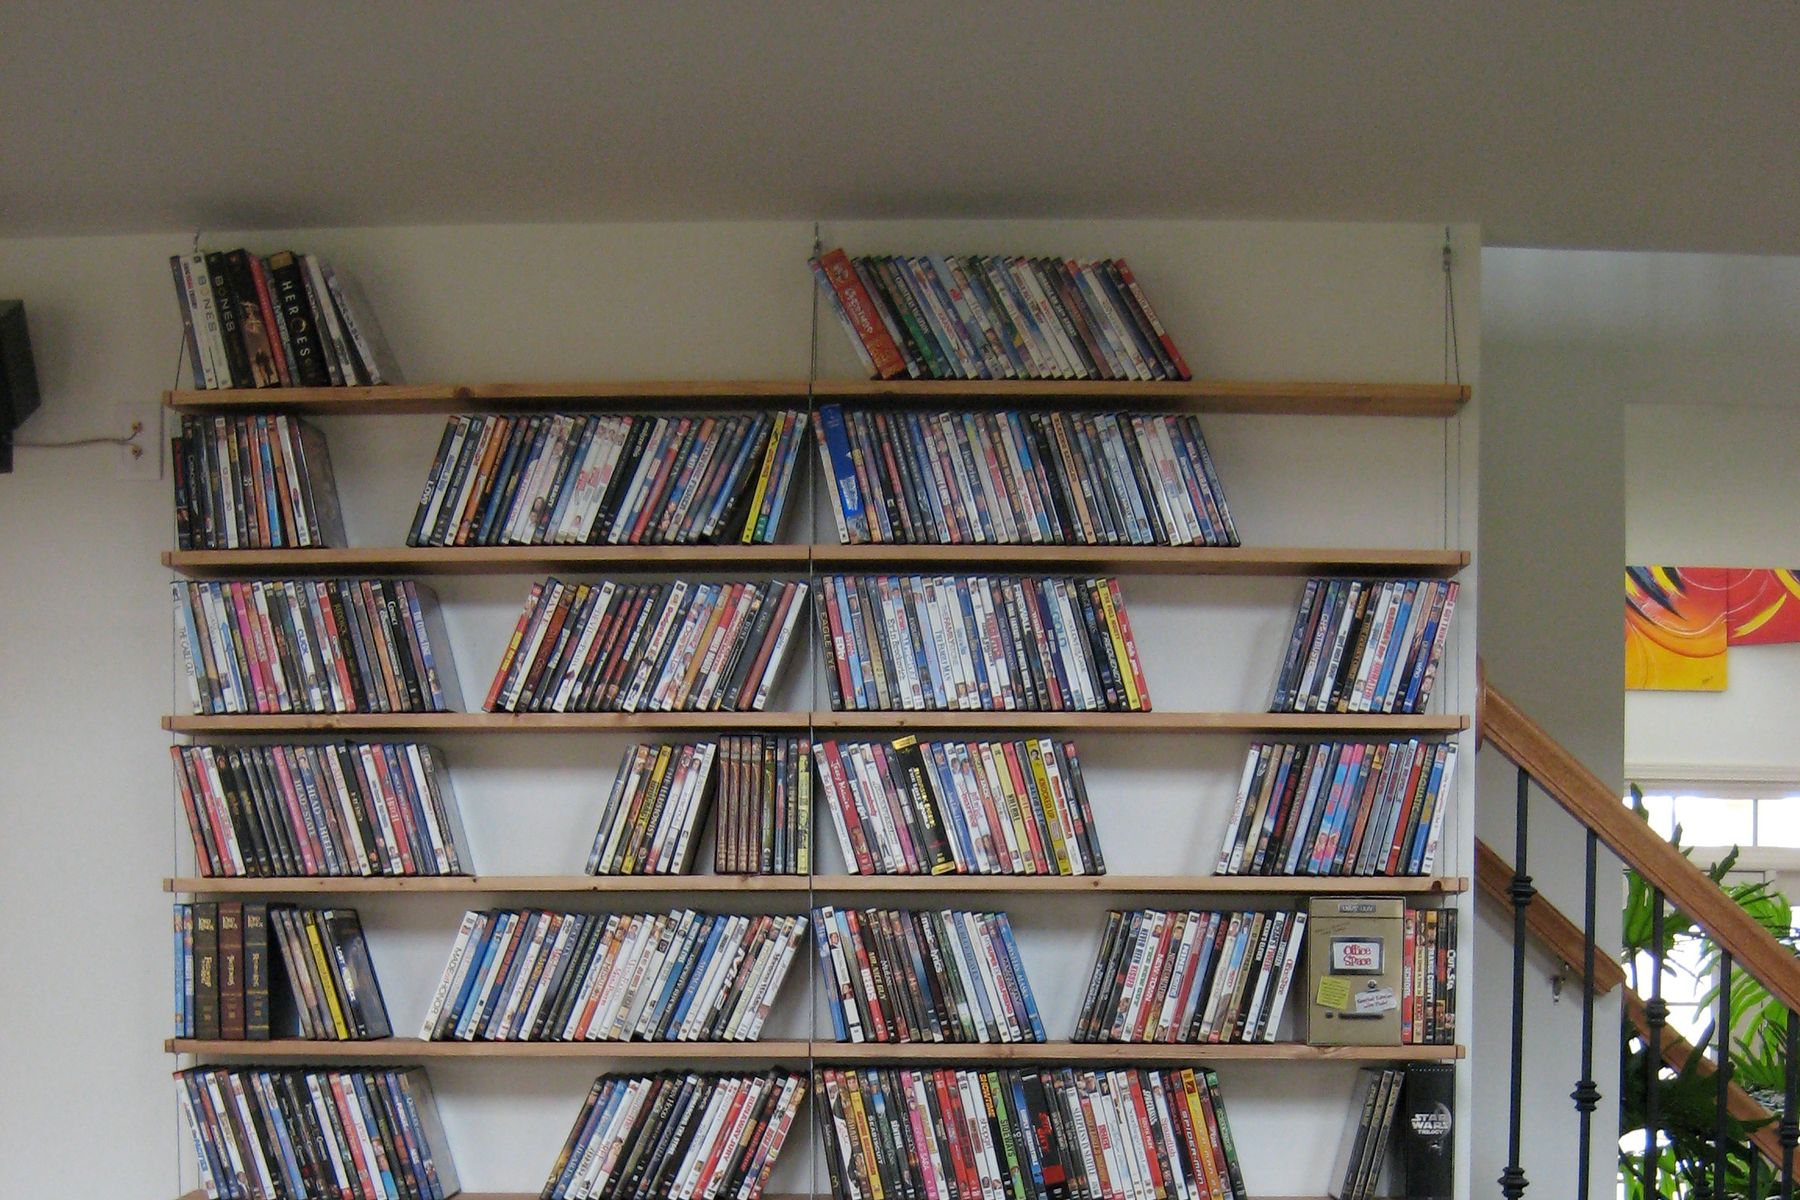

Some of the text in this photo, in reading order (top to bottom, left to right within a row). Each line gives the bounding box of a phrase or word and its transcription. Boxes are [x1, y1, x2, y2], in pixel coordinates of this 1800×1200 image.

[1013, 583, 1031, 634] FIREWALL
[820, 612, 831, 647] EAGLE
[1101, 630, 1122, 684] FREQUENCY
[920, 916, 934, 944] music
[1343, 945, 1372, 956] Office
[1343, 955, 1372, 966] Space
[978, 1073, 995, 1118] SHOWTIME
[999, 1118, 1016, 1158] SIDEWAYS
